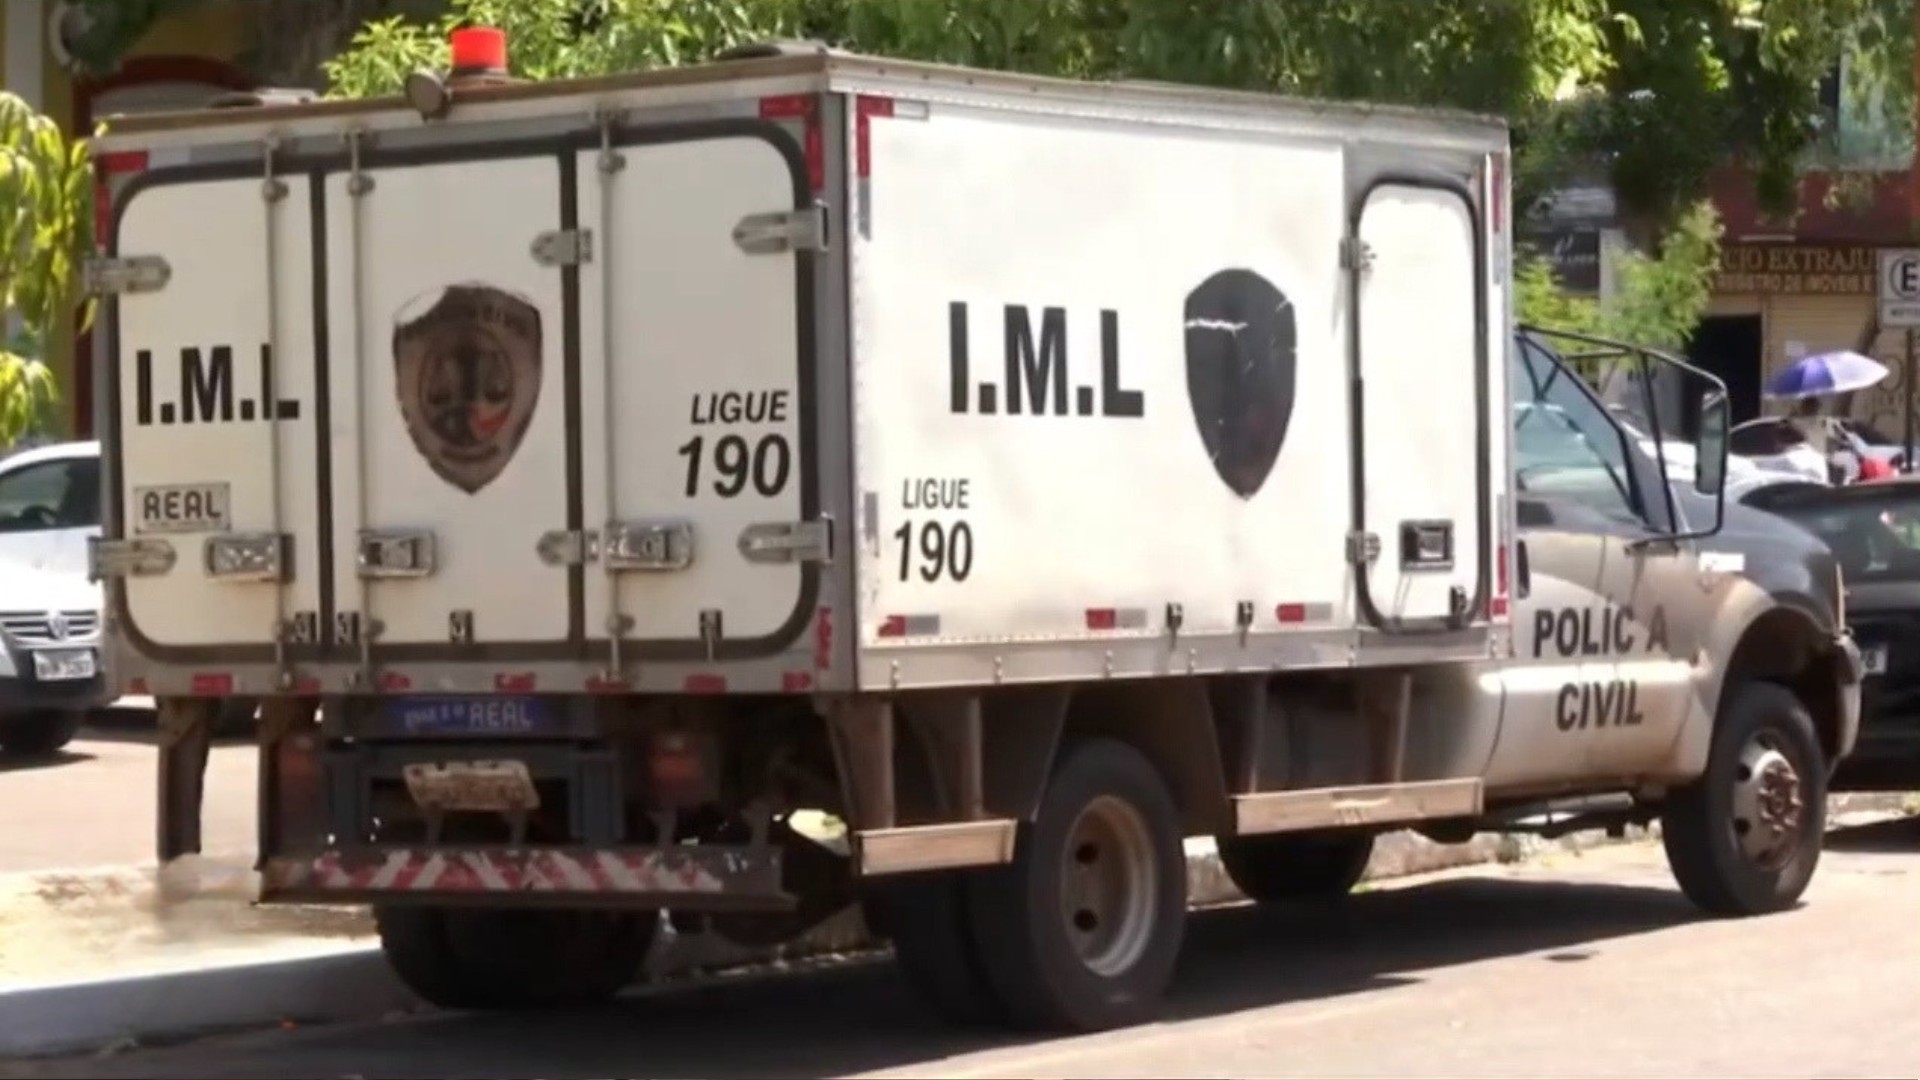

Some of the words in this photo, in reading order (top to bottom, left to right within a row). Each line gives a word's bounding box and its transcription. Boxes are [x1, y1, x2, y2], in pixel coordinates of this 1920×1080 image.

[1901, 262, 1917, 292] E
[949, 301, 1144, 417] I.M.L
[690, 390, 789, 424] LIGUE
[678, 433, 790, 497] 190
[144, 491, 221, 519] REAL
[902, 478, 970, 509] LIGUE
[895, 520, 972, 582] 190
[1556, 679, 1643, 732] CIVIL
